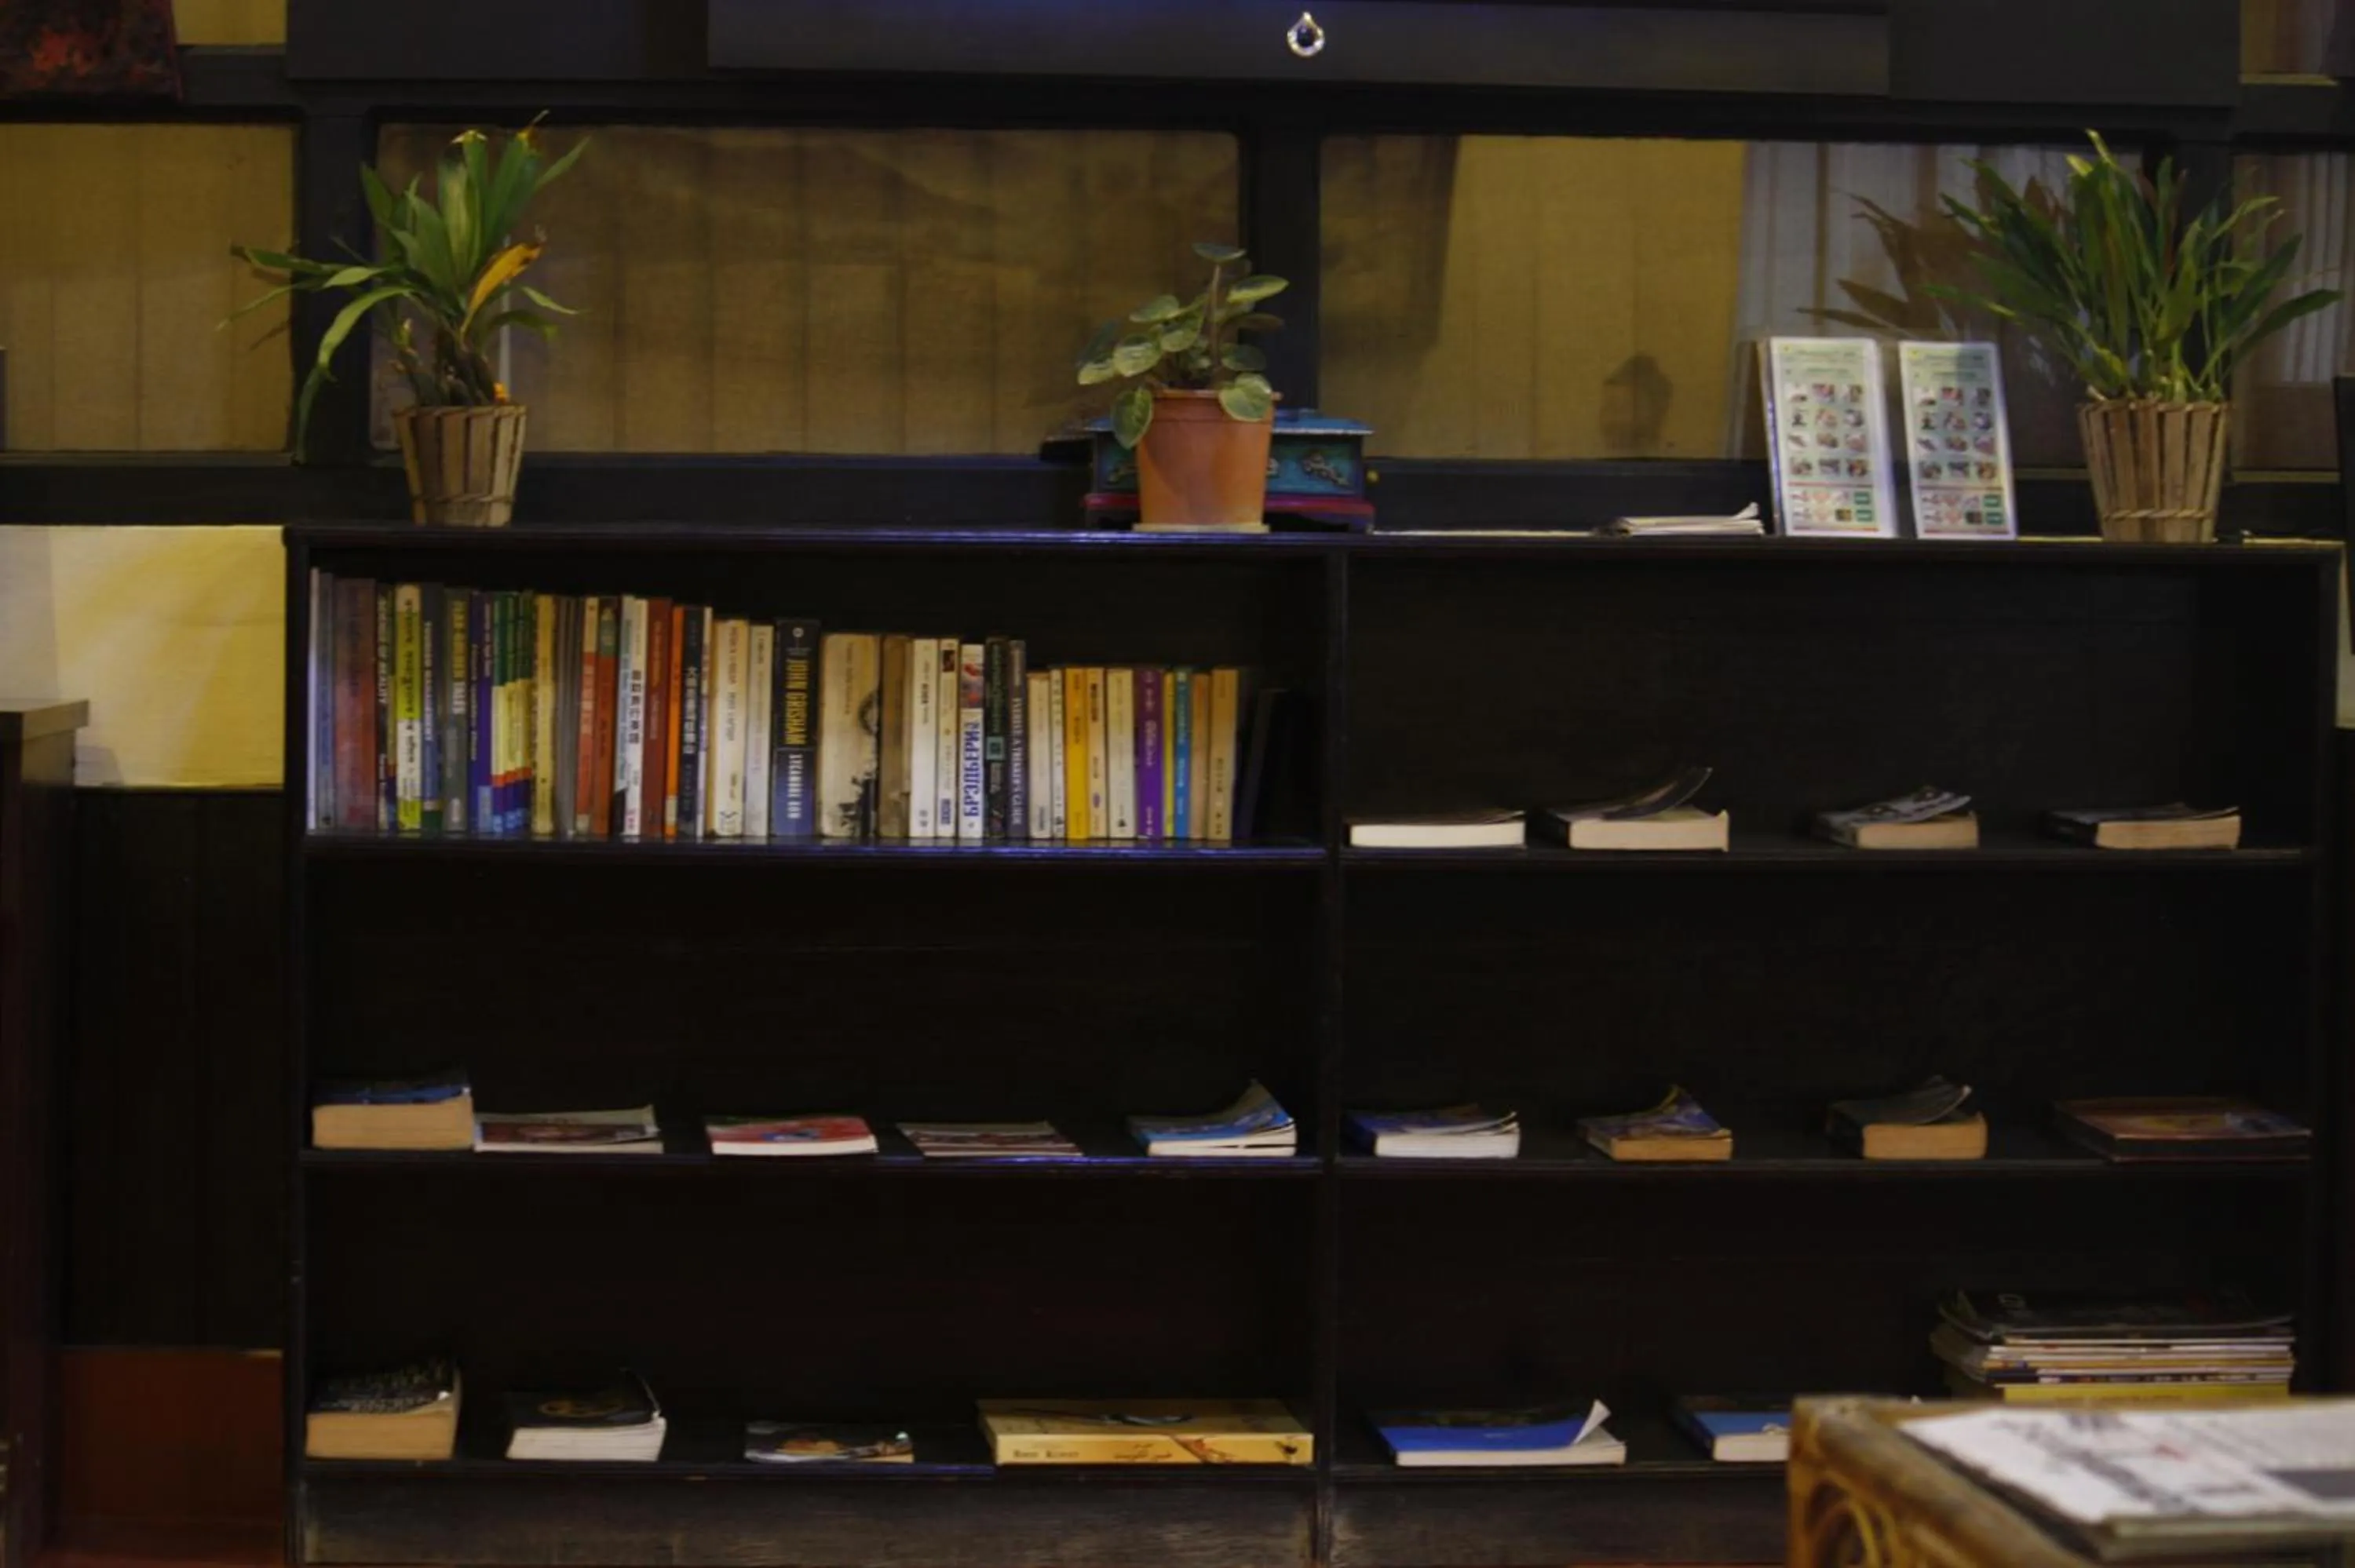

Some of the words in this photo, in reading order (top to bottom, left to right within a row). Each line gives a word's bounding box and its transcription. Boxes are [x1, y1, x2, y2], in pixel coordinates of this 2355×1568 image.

[786, 659, 809, 689] JOHN
[785, 691, 809, 746] GRISHAM
[787, 753, 804, 798] SYCAMORE
